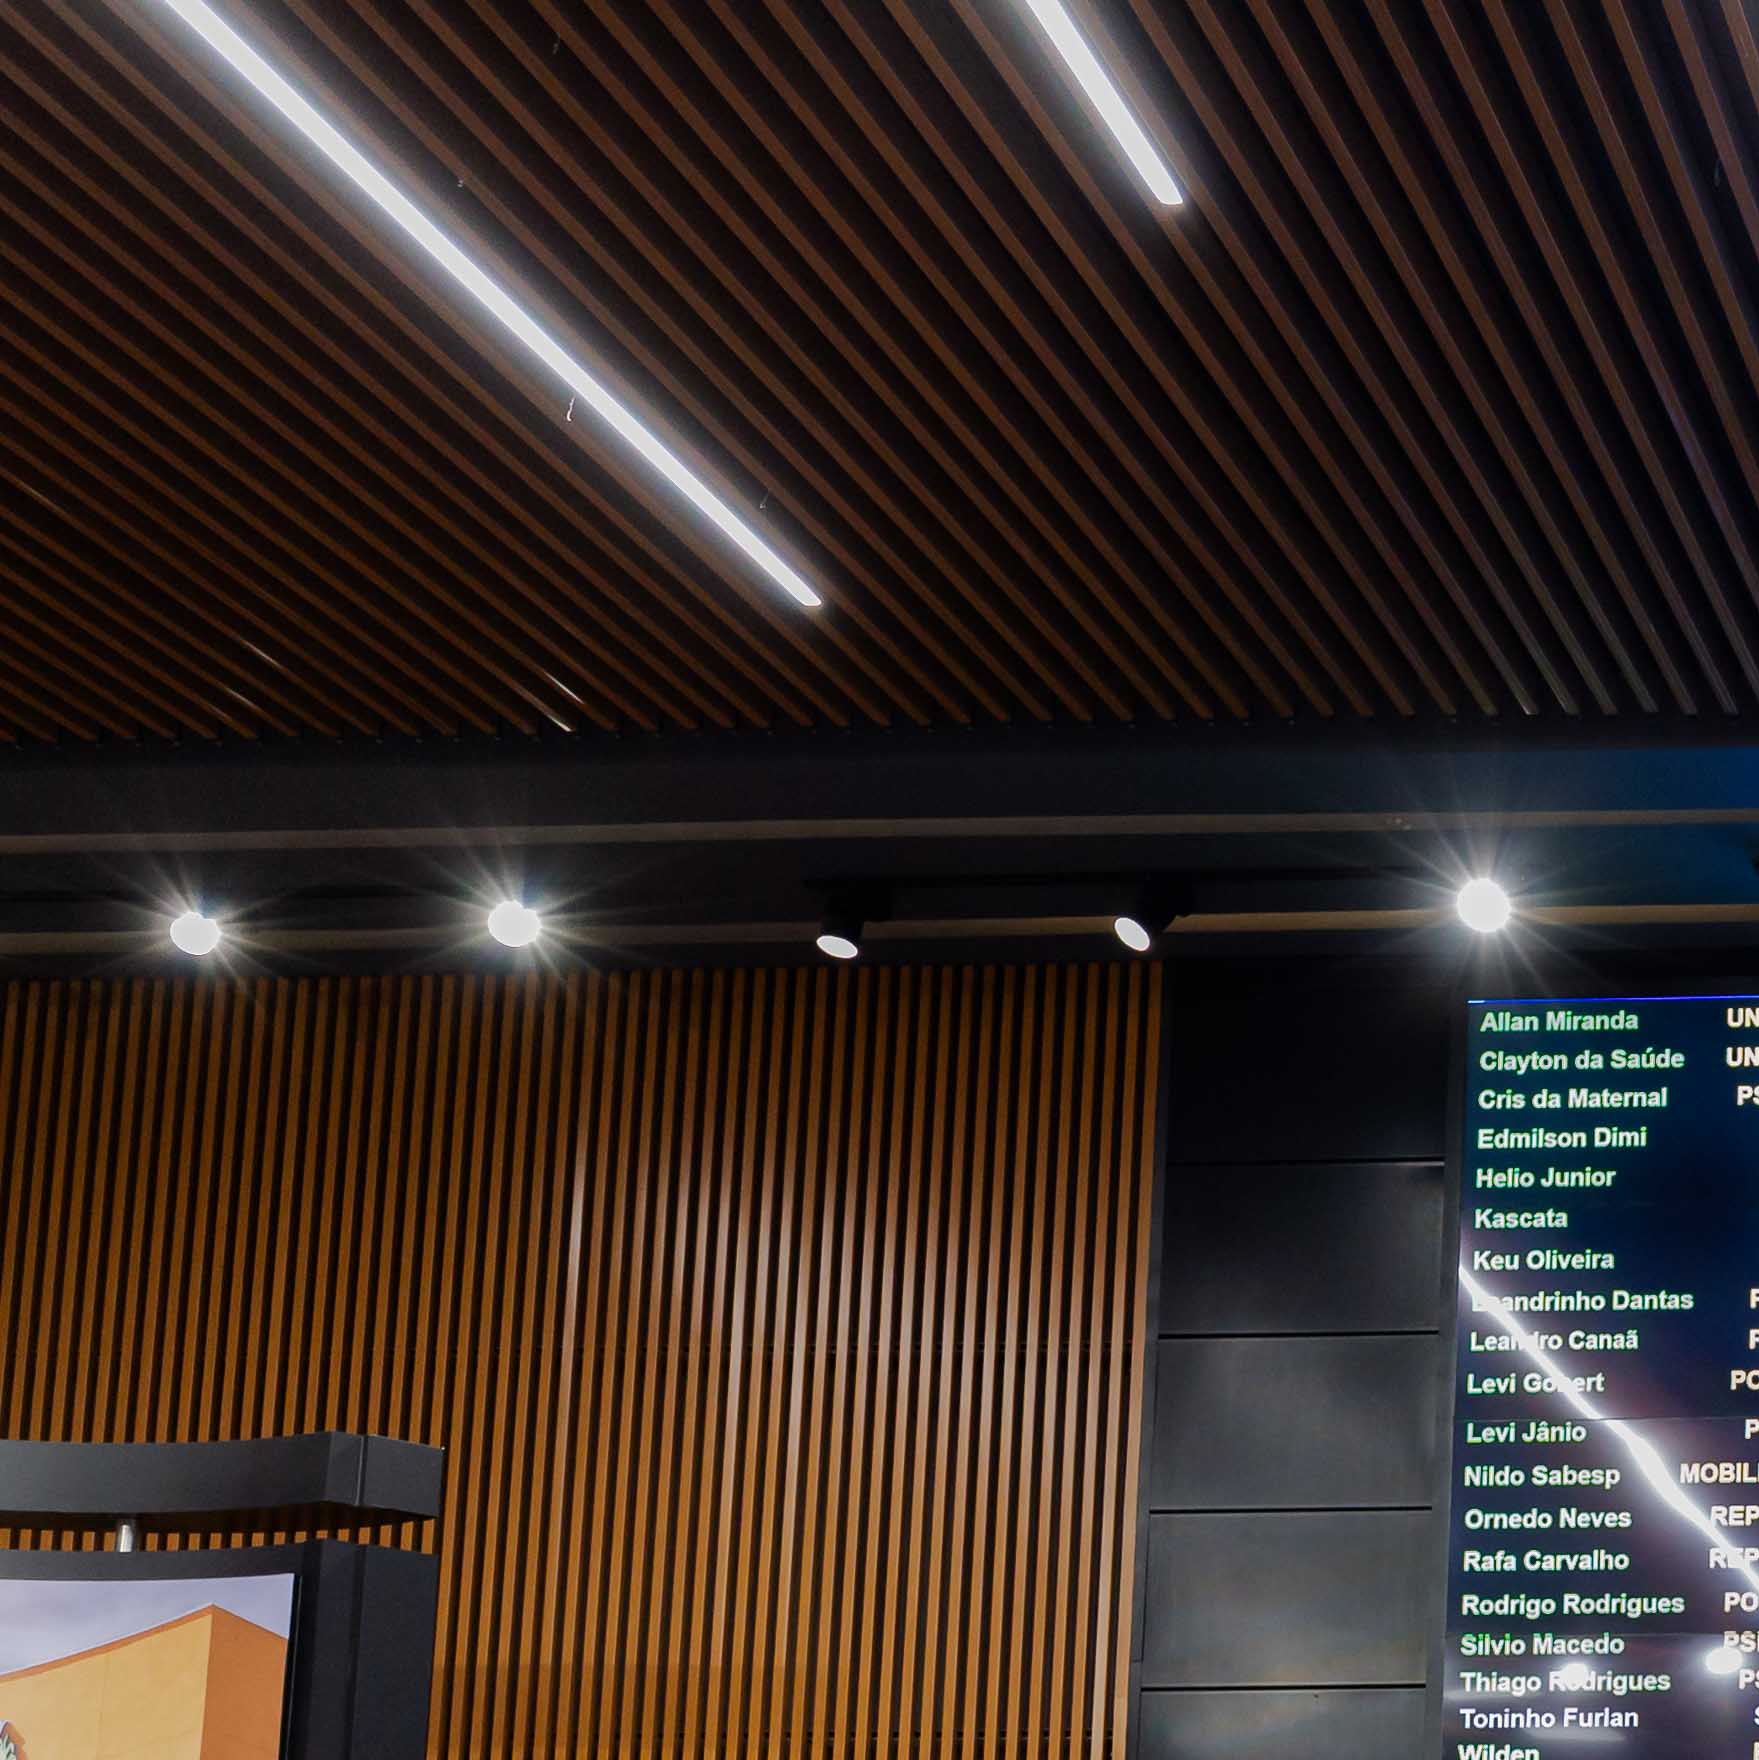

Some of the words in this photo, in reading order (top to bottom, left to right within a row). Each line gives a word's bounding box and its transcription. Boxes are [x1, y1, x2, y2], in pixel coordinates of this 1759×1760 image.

[1481, 1013, 1540, 1032] Allan
[1545, 1011, 1639, 1030] Miranda
[1480, 1051, 1568, 1074] Clayton
[1574, 1052, 1602, 1069] da
[1610, 1048, 1685, 1068] Saúde
[1478, 1090, 1526, 1110] Cris
[1532, 1090, 1560, 1108] da
[1568, 1088, 1667, 1108] Maternal
[1477, 1129, 1587, 1149] Edmilson
[1594, 1128, 1647, 1147] Dimi
[1476, 1169, 1534, 1188] Helio
[1541, 1168, 1616, 1187] Junior
[1475, 1210, 1567, 1229] Kascata
[1473, 1252, 1521, 1270] Keu
[1528, 1250, 1614, 1270] Oliveira
[1612, 1291, 1693, 1310] Dantas
[1569, 1330, 1638, 1350] Canaã
[1467, 1373, 1515, 1394] Levi
[1467, 1423, 1515, 1442] Levi
[1522, 1422, 1586, 1442] Jânio
[1464, 1467, 1525, 1487] Nildo
[1532, 1466, 1620, 1490] Sabesp
[1465, 1510, 1552, 1529] Ornedo
[1560, 1508, 1632, 1528] Neves
[1463, 1552, 1516, 1572] Rafa
[1524, 1551, 1630, 1570] Carvalho
[1462, 1595, 1556, 1619] Rodrigo
[1563, 1594, 1685, 1617] Rodrigues
[1461, 1635, 1524, 1656] Silvio
[1531, 1635, 1625, 1655] Macedo
[1460, 1673, 1542, 1695] Thiago
[1460, 1708, 1556, 1729] Toninho
[1563, 1708, 1638, 1728] Furlan
